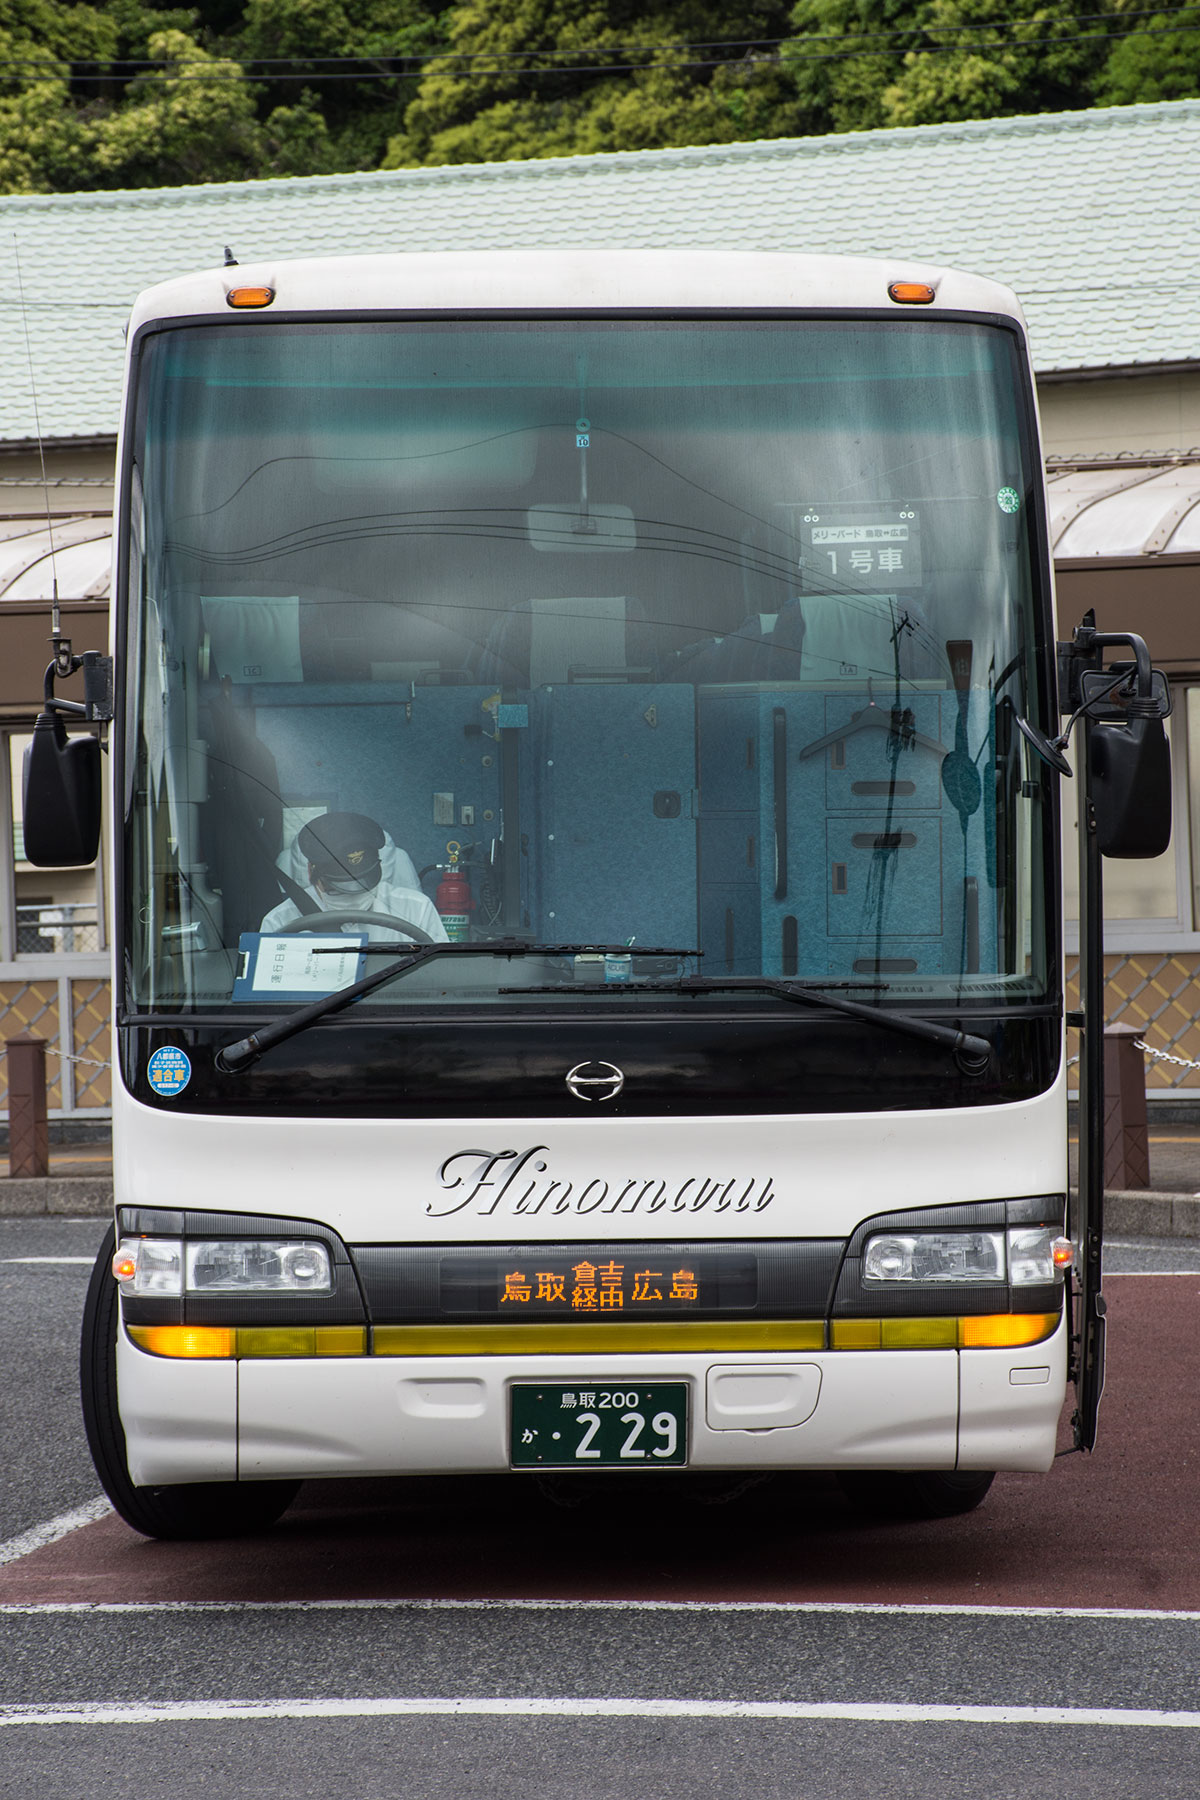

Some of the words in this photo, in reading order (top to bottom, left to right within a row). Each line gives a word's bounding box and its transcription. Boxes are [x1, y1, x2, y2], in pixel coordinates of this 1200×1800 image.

[813, 528, 861, 540] メリーバード
[827, 547, 904, 575] 1号車
[424, 1145, 775, 1217] Hinomaru
[500, 1271, 567, 1302] 鳥取
[631, 1269, 698, 1301] 広島
